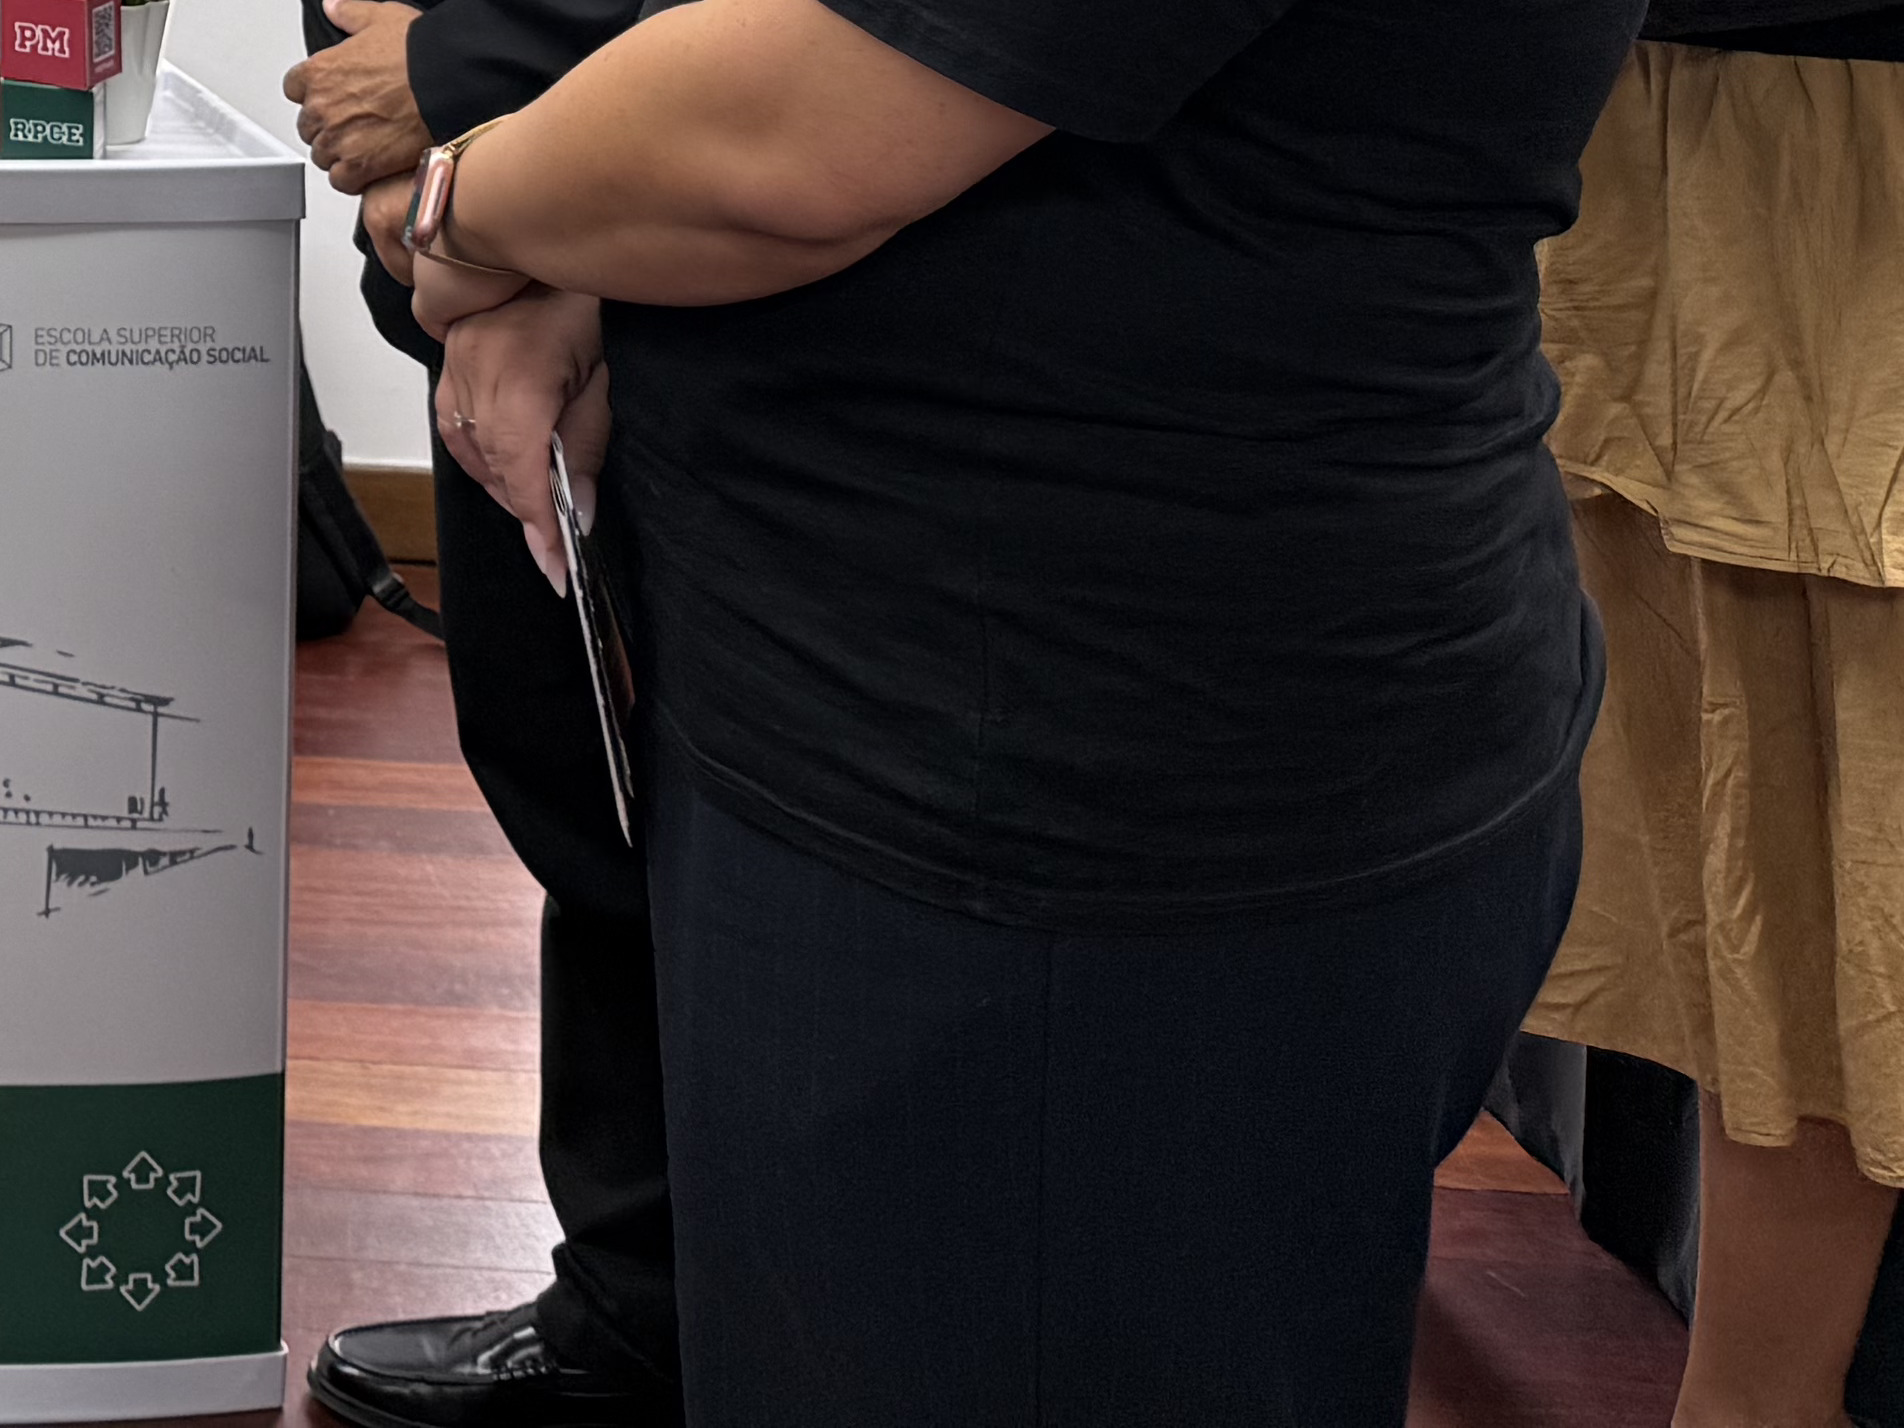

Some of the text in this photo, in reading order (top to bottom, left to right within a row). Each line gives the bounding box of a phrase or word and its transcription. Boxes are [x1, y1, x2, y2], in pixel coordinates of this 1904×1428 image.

[14, 21, 70, 58] PM
[10, 118, 84, 146] RPCE
[34, 325, 216, 345] ESCOLA SUPERIOR
[34, 345, 270, 370] DE COMUNICAÇÃO SOCIAL
